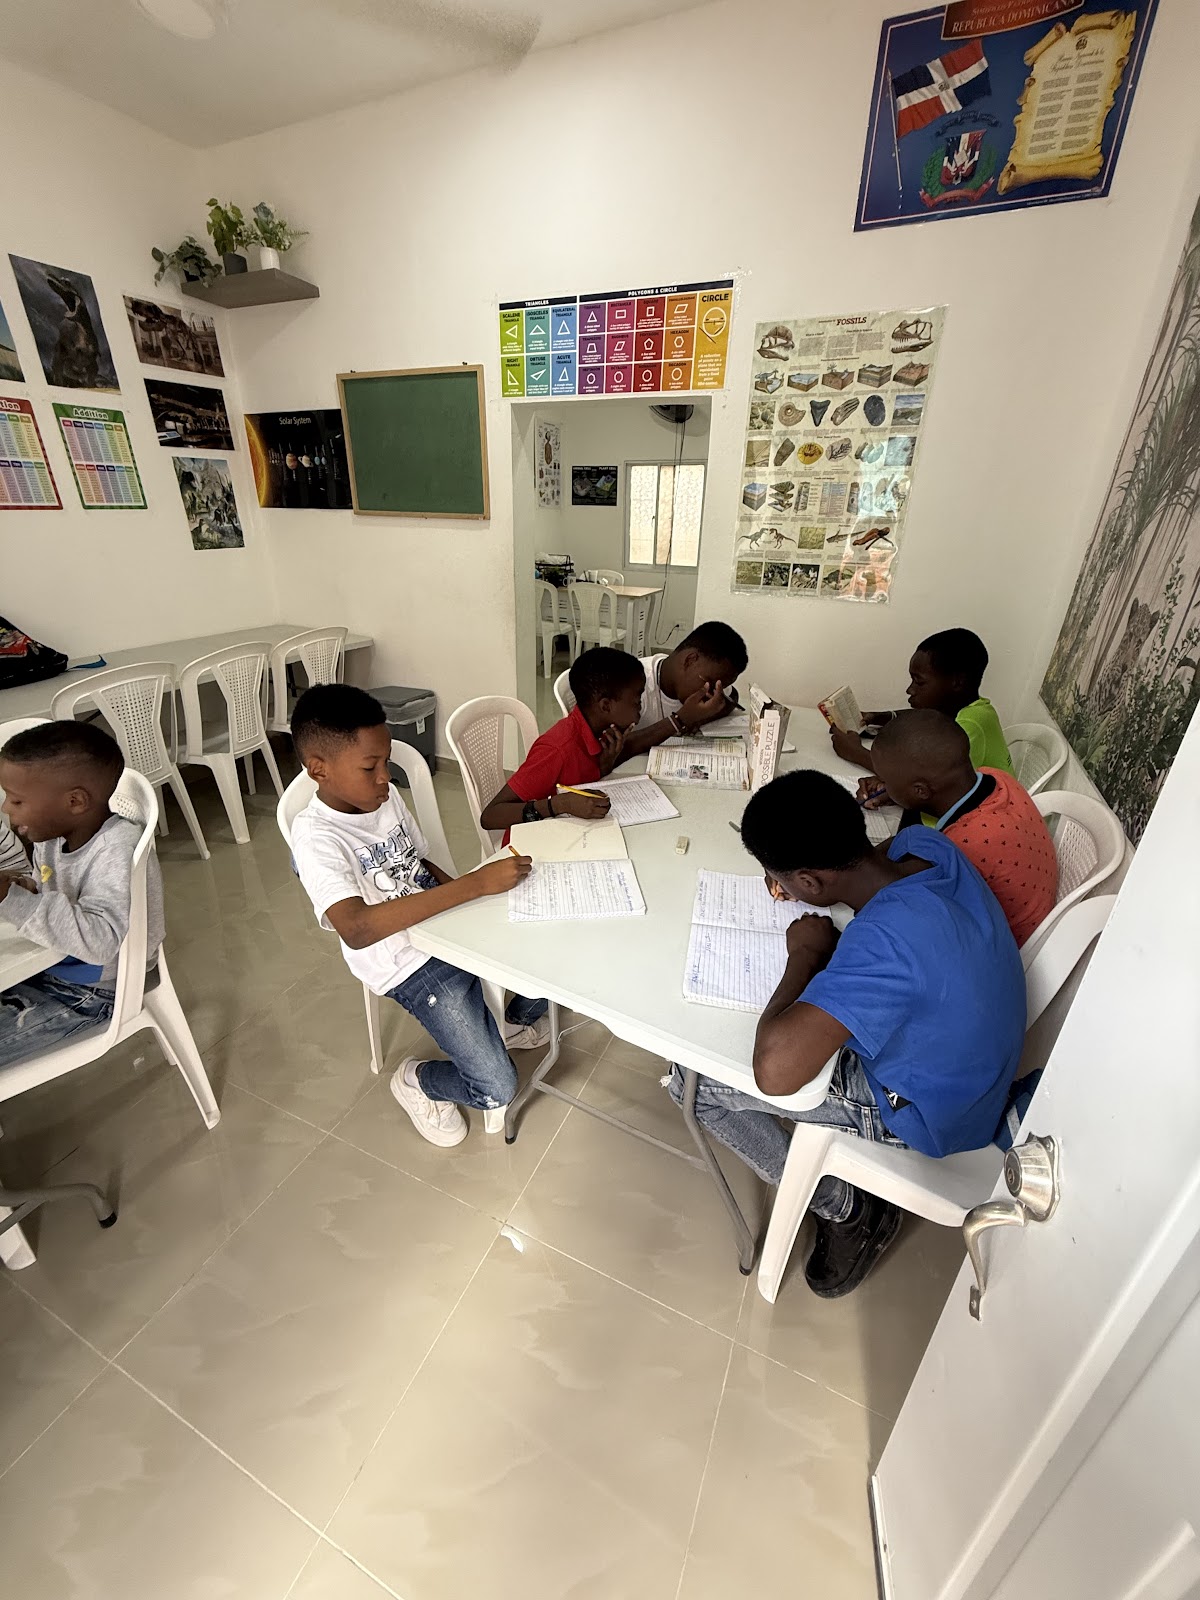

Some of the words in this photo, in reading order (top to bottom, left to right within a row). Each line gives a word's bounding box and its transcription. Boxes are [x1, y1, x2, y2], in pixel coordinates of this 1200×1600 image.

[525, 299, 549, 307] TRIANGLES
[701, 293, 729, 303] CIRCLE
[836, 316, 868, 326] FOSSILS
[74, 409, 108, 418] Addition
[279, 416, 292, 425] Solar
[293, 416, 312, 426] System
[765, 722, 774, 750] PUZZLE
[761, 752, 770, 785] POSSIBLE
